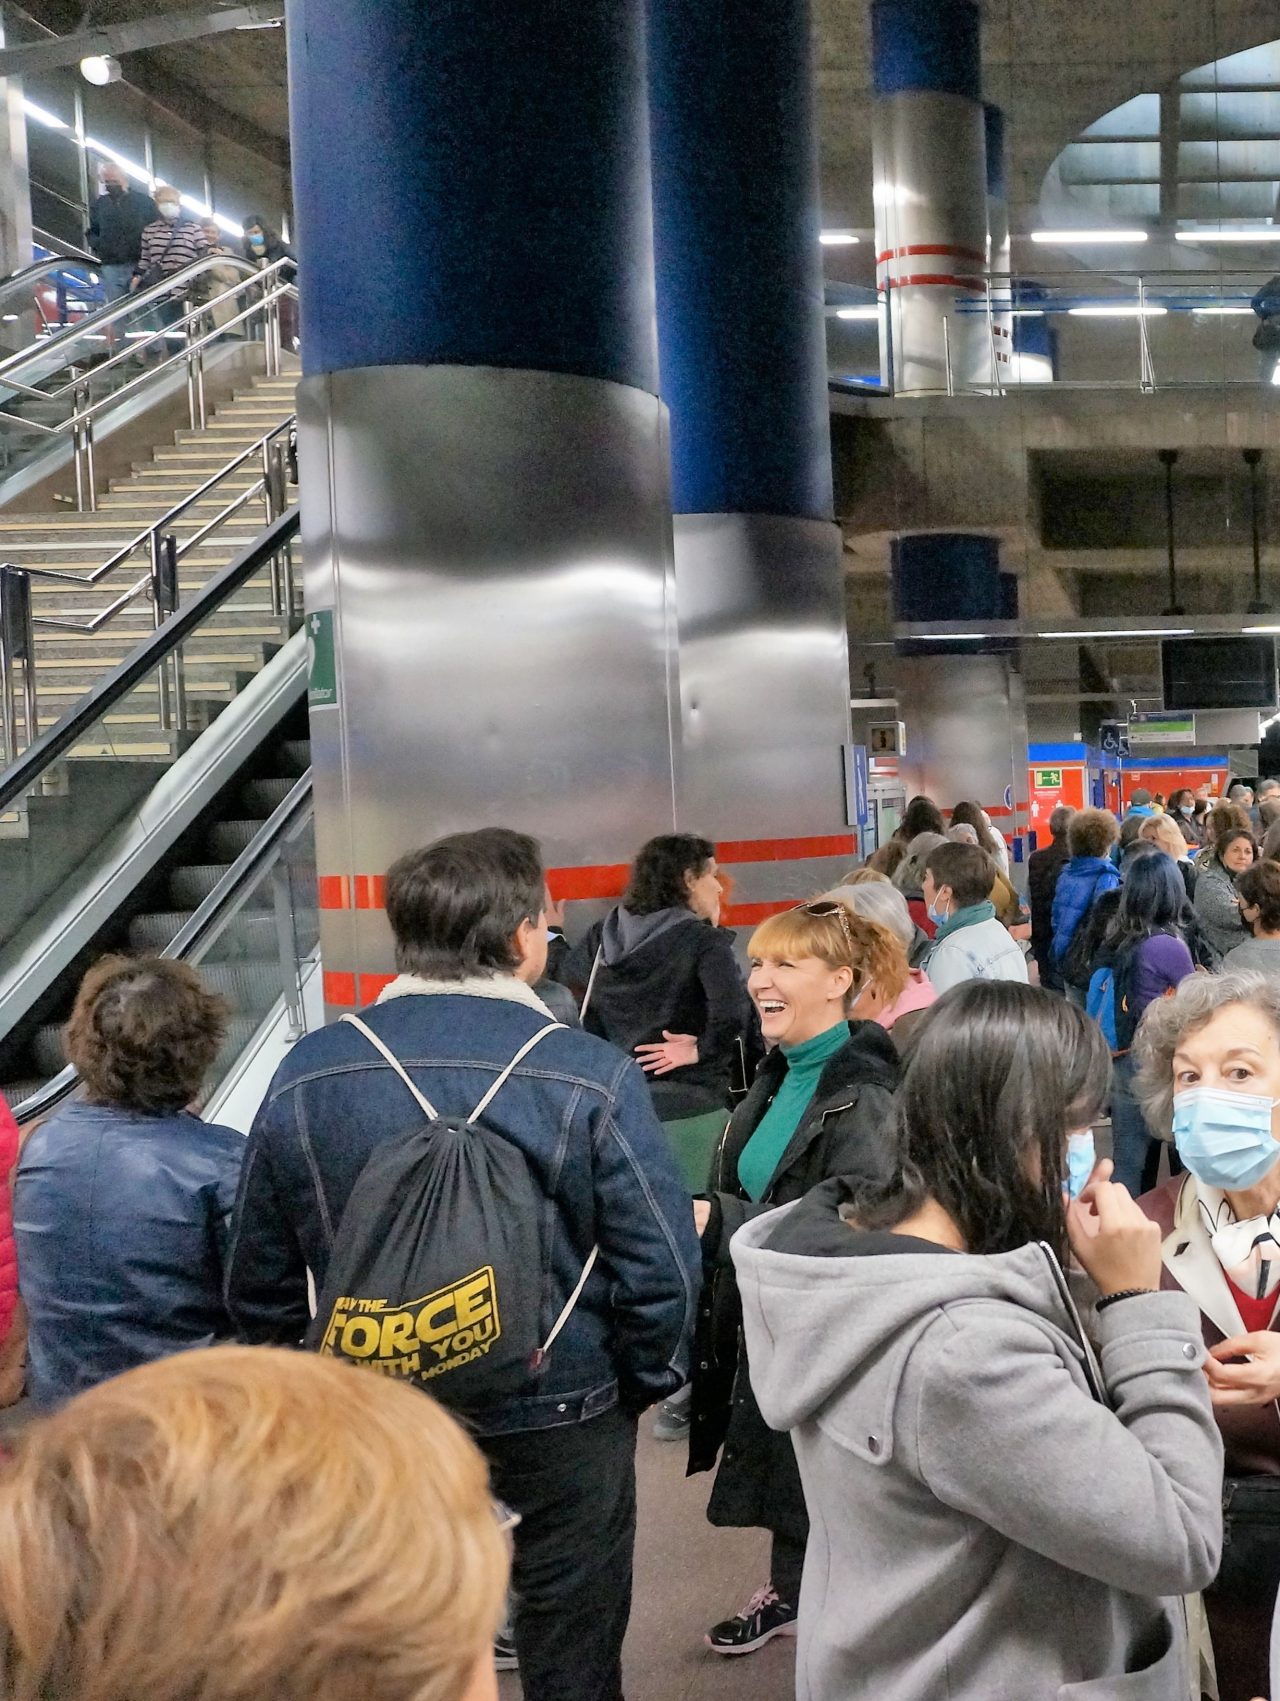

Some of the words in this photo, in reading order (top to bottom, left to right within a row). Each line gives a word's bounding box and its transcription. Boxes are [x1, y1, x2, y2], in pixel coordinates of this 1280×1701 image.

[358, 1299, 388, 1312] THE
[431, 1316, 493, 1360] YOU
[421, 1342, 491, 1381] MONDAY
